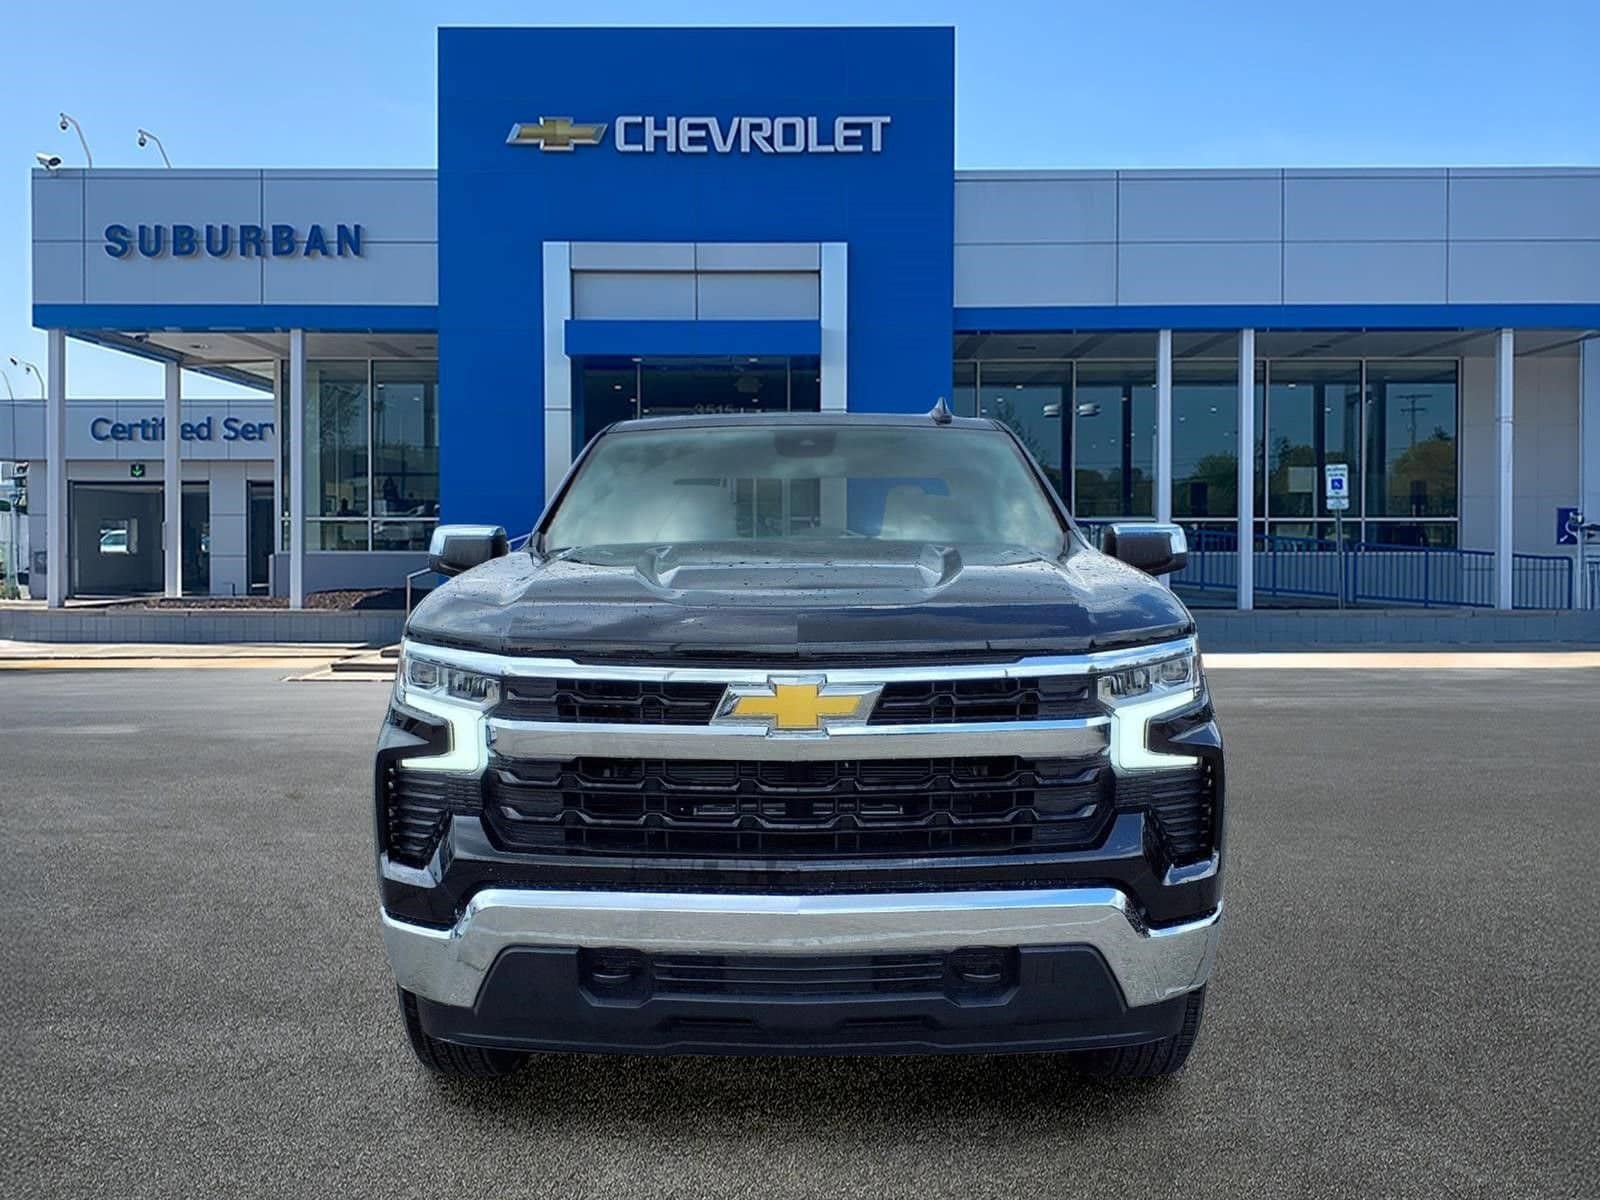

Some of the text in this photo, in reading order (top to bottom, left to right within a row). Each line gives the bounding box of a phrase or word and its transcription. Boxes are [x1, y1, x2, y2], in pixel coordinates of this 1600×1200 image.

[615, 116, 891, 152] CHEVROLET
[104, 224, 361, 257] SUBURBAN
[90, 416, 212, 441] Certifed
